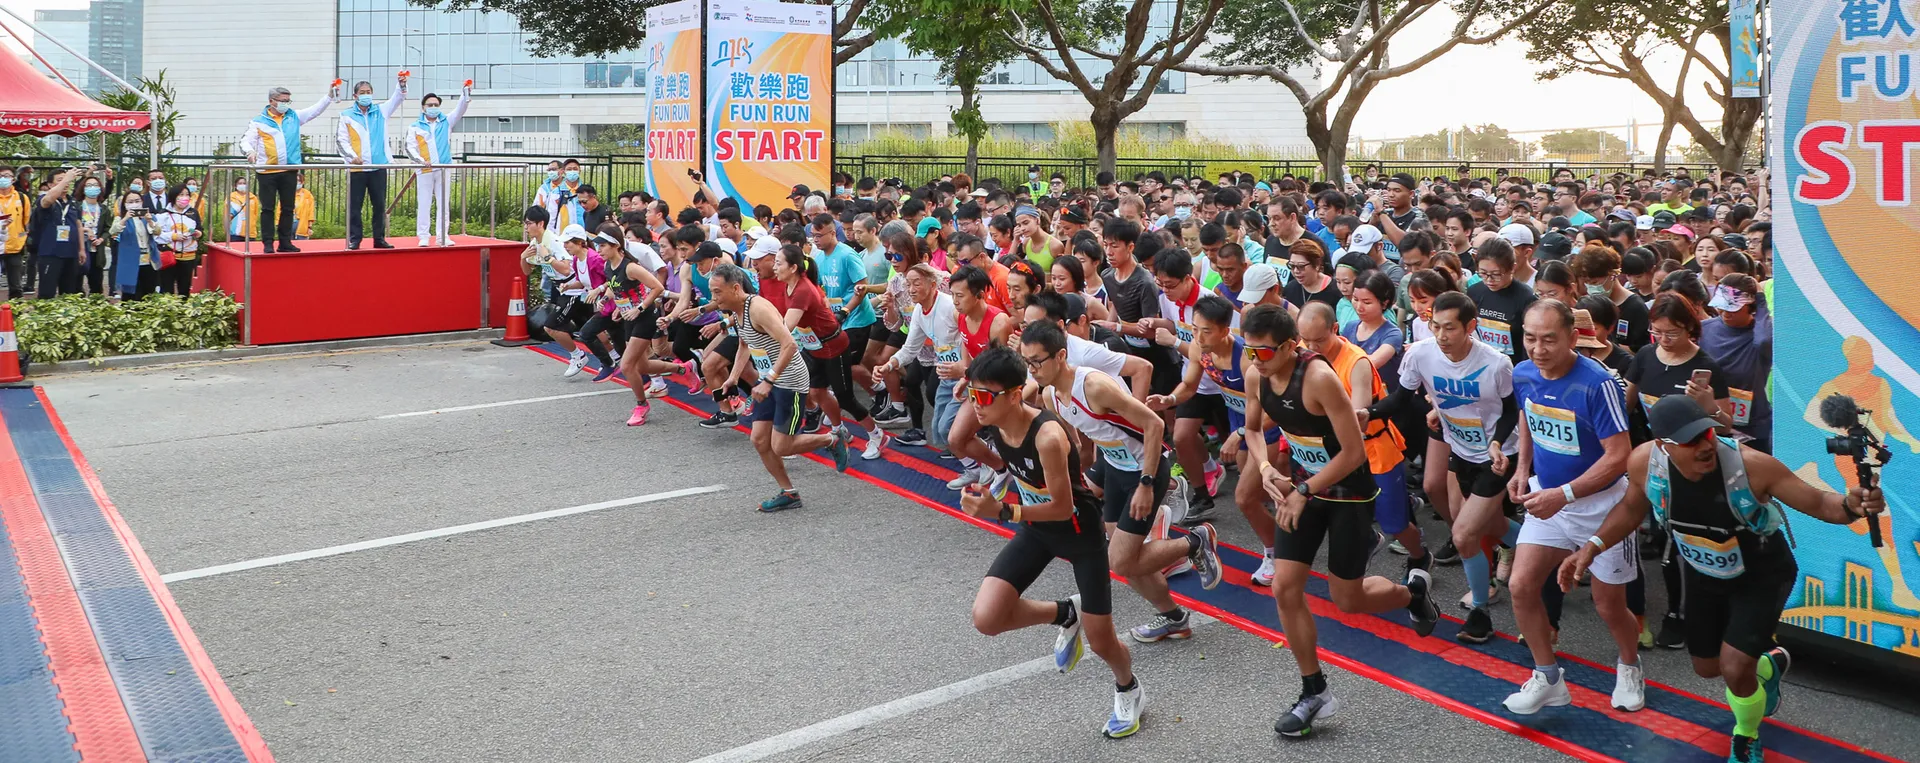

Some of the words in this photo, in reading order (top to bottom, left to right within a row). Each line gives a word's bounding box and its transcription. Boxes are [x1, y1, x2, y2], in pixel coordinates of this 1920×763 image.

[655, 72, 689, 99] 歡樂跑
[731, 72, 809, 100] 歡樂跑
[655, 105, 670, 120] FUN
[673, 104, 689, 120] RUN
[731, 105, 765, 121] FUN
[774, 105, 809, 121] RUN
[648, 131, 695, 160] START
[716, 131, 823, 160] START
[1799, 125, 1920, 201] ST
[1480, 308, 1508, 321] BARREL
[1433, 376, 1480, 397] RUN
[1529, 415, 1573, 442] B4215
[1680, 543, 1738, 568] B2599
